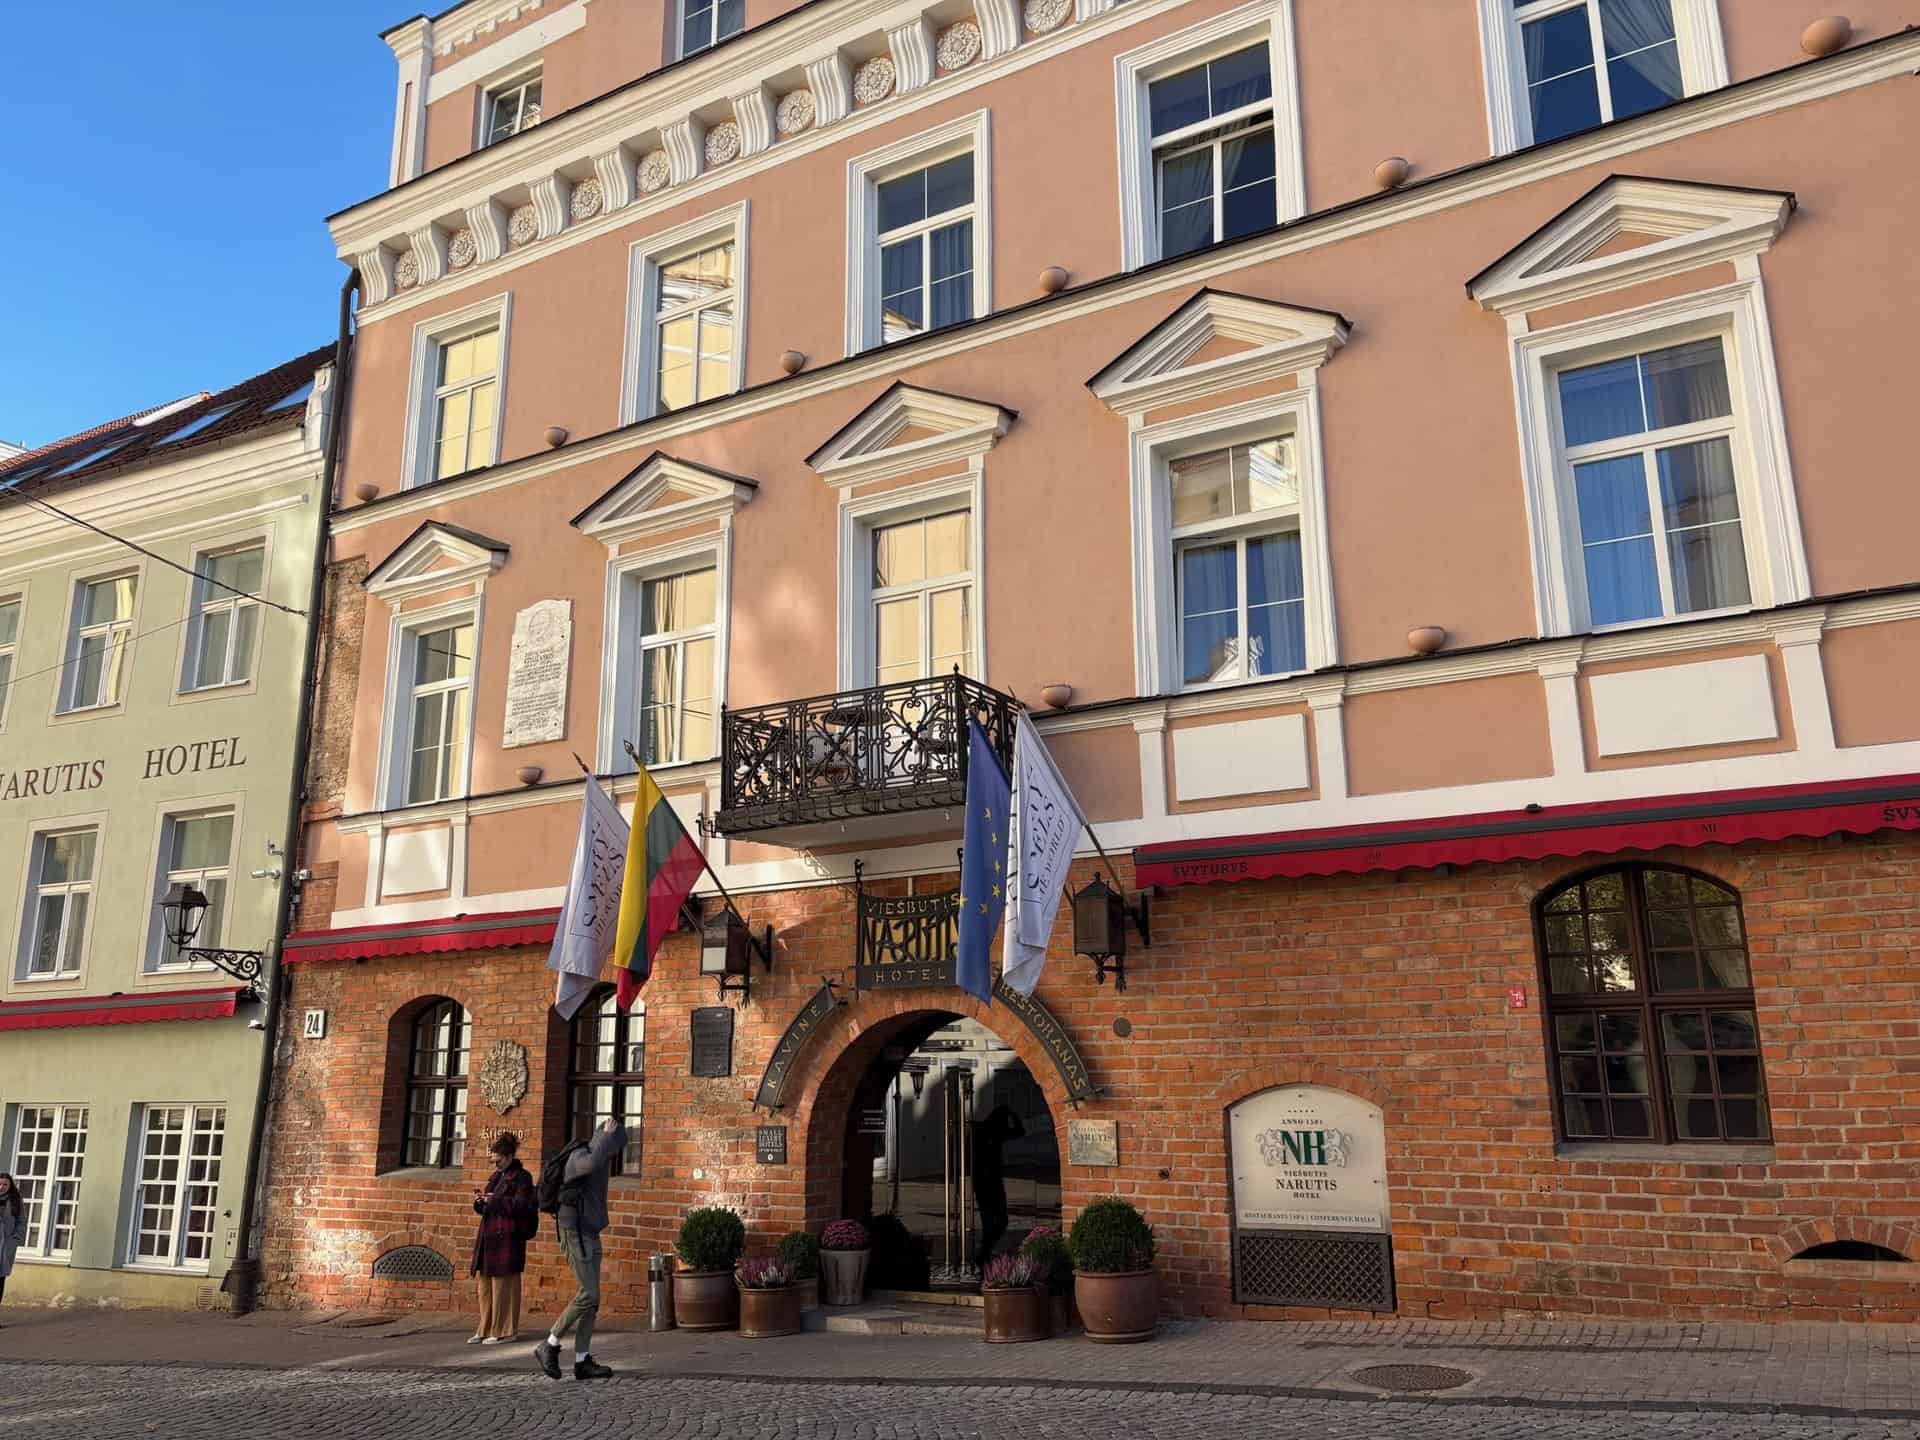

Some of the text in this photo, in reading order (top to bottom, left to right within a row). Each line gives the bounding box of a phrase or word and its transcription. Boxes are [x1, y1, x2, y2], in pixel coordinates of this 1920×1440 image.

[142, 736, 248, 780] HOTEL
[875, 968, 946, 983] HOTEL
[306, 1013, 320, 1034] 24
[1000, 983, 1087, 1091] RESTORANAS
[1280, 1130, 1329, 1166] NH
[1276, 1178, 1337, 1191] NARUTIS
